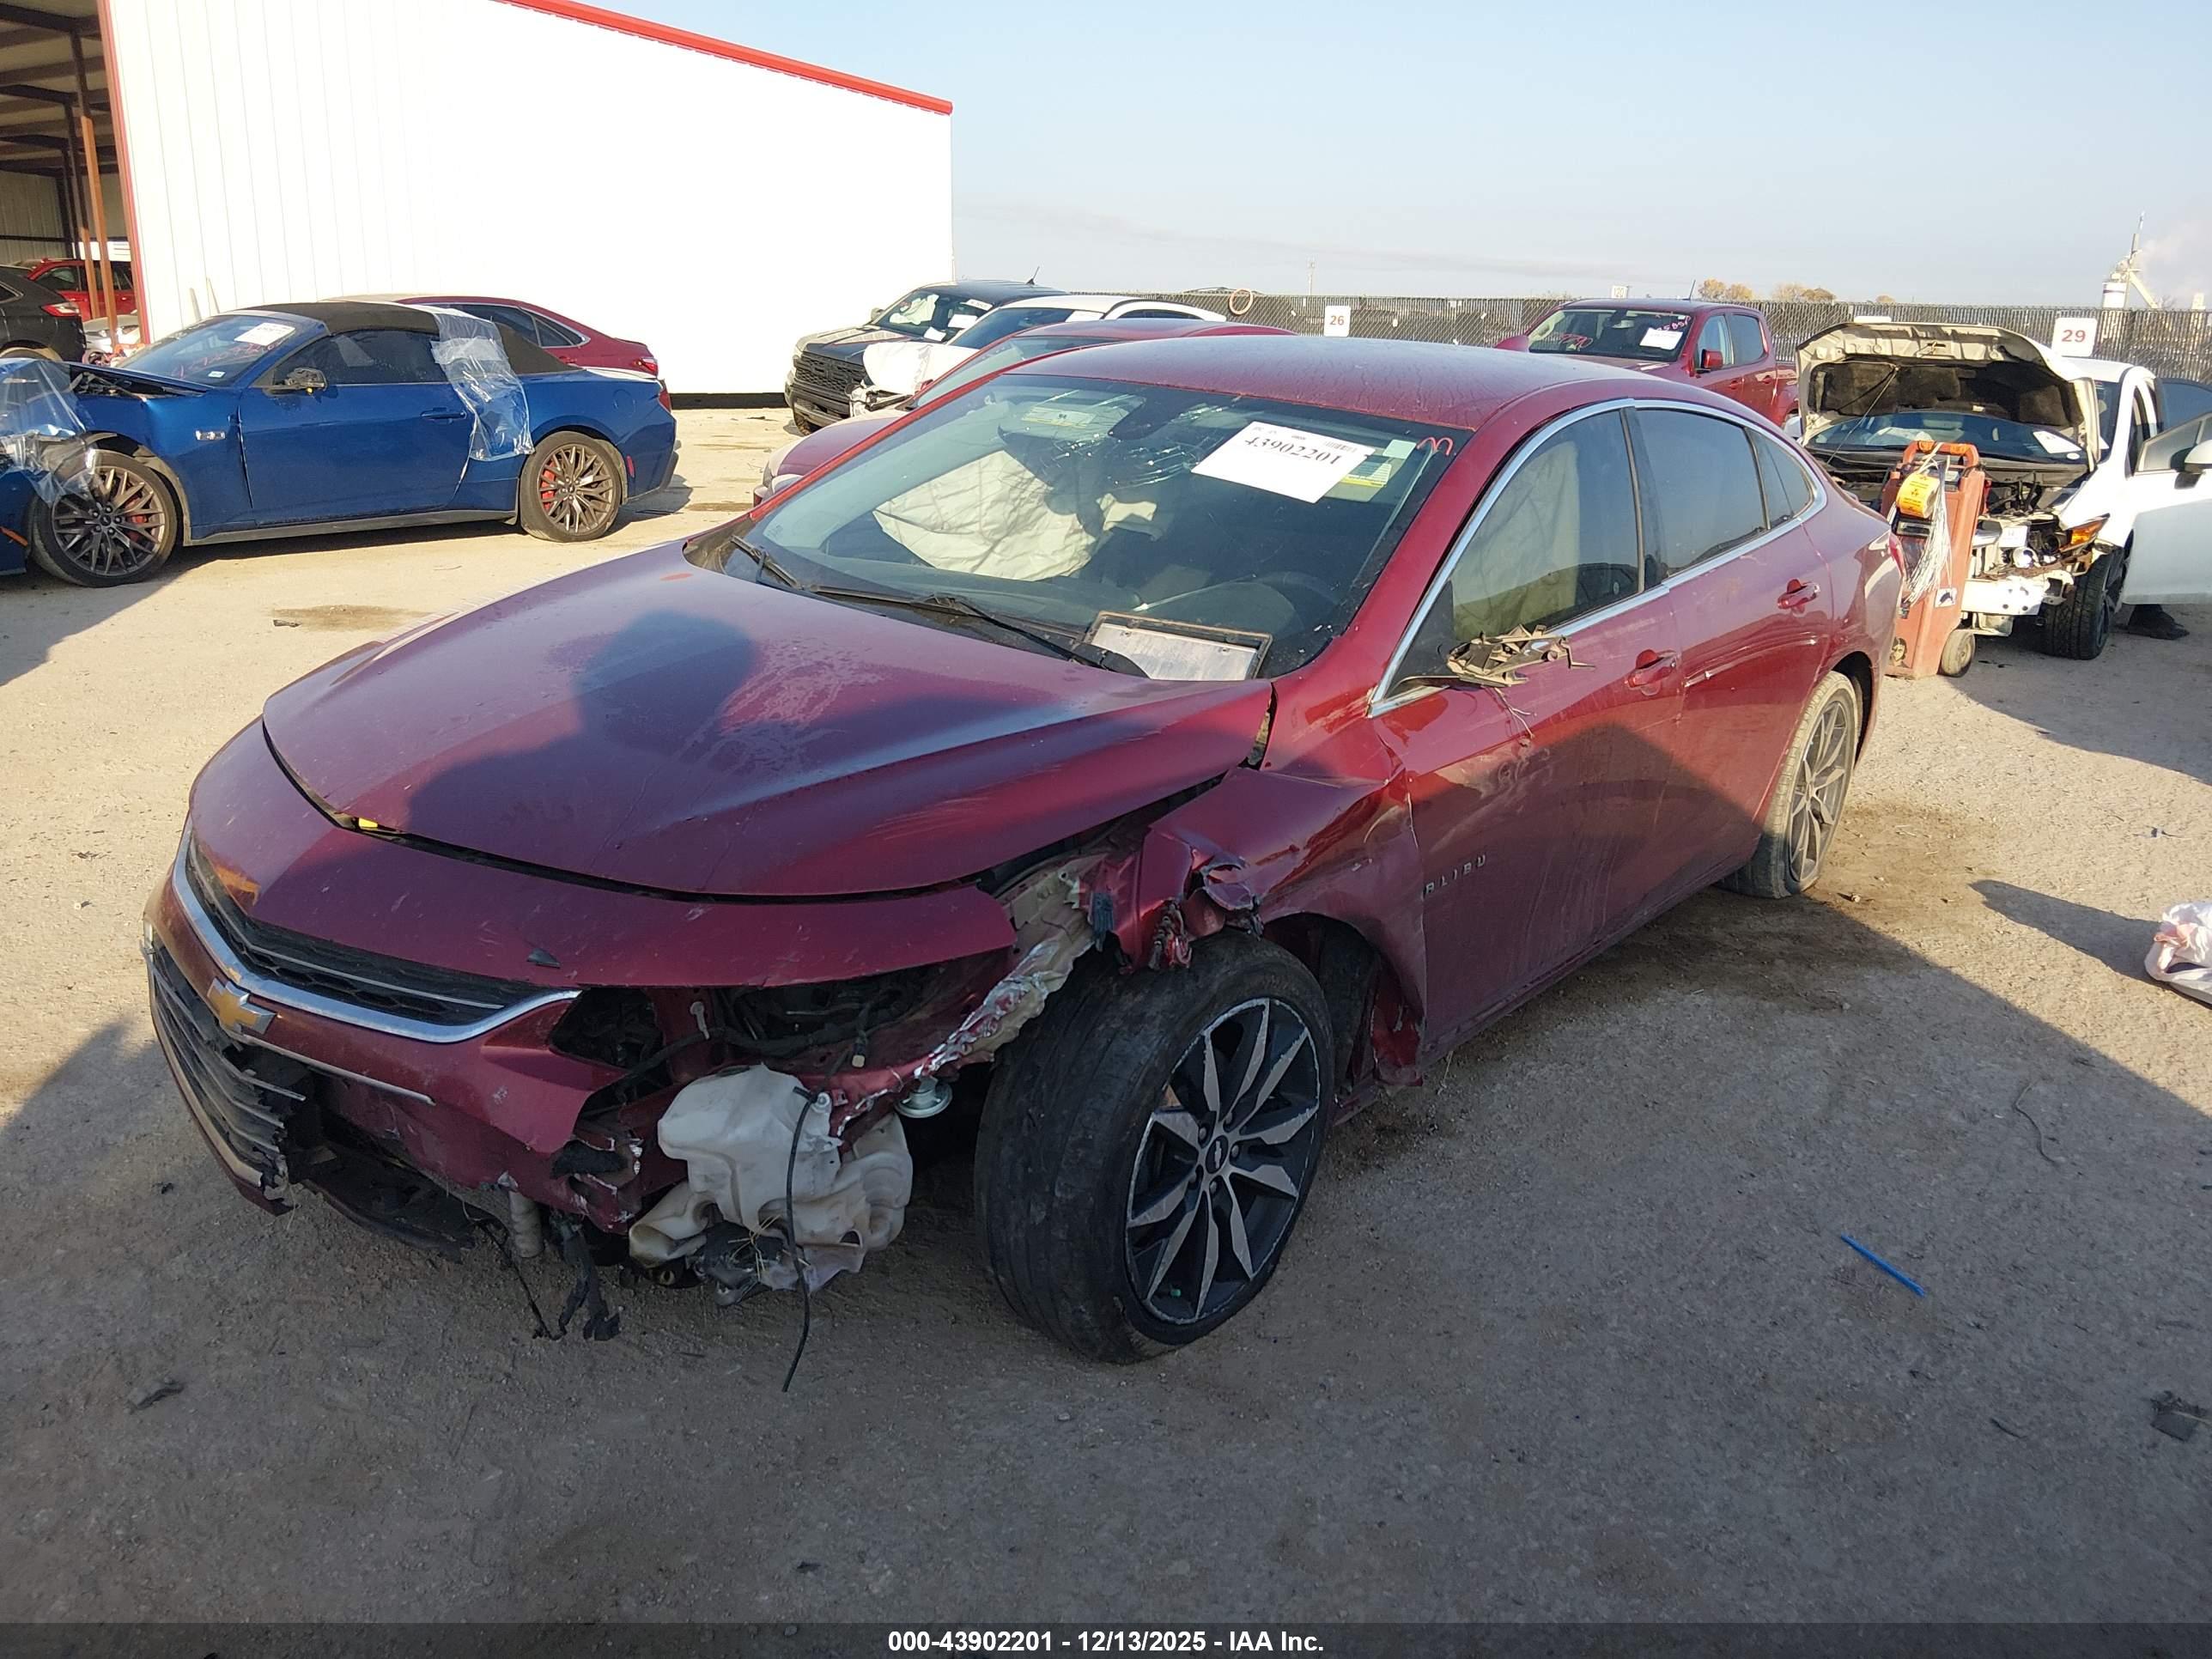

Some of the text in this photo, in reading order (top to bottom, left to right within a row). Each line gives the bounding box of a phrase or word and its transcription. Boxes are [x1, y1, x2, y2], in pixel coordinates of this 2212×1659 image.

[1330, 315, 1345, 325] 26
[2061, 329, 2086, 343] 29
[1245, 436, 1341, 465] 43902201
